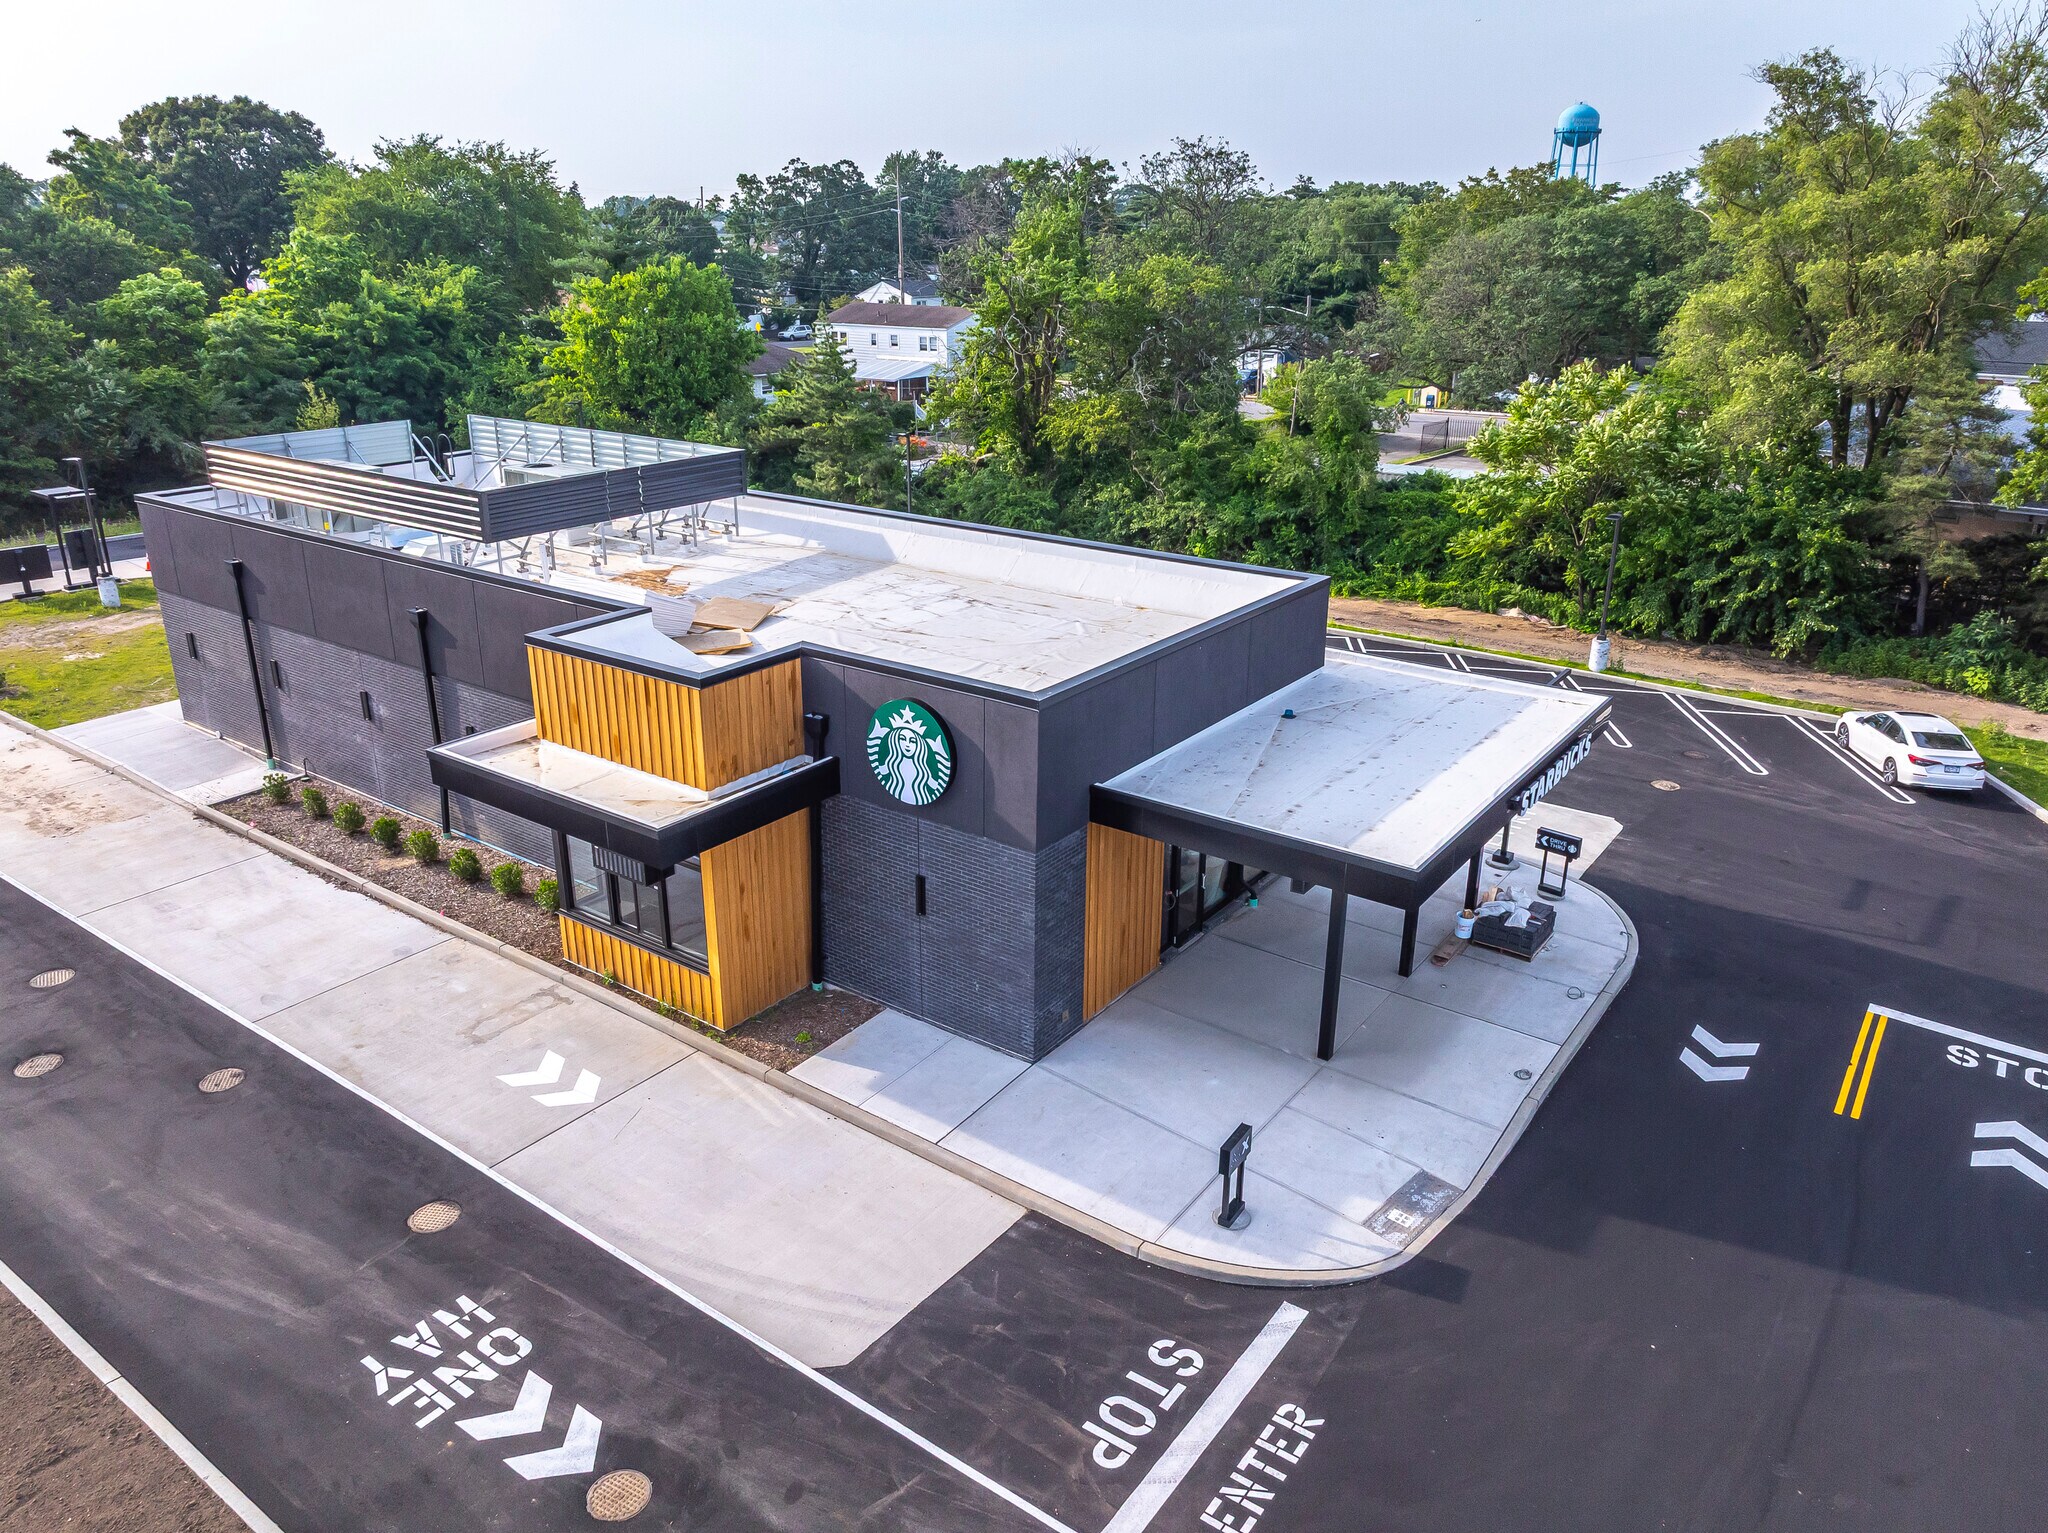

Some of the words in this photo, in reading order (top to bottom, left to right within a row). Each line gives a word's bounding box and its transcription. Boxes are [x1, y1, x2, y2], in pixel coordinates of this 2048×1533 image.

[1520, 733, 1592, 817] STARBUCKS
[1549, 837, 1567, 847] DRIVE
[1549, 842, 1566, 852] THRU
[360, 1294, 497, 1396] WAY
[387, 1327, 533, 1429] ONE
[1082, 1339, 1204, 1469] STOP
[1200, 1403, 1326, 1533] ENTER
